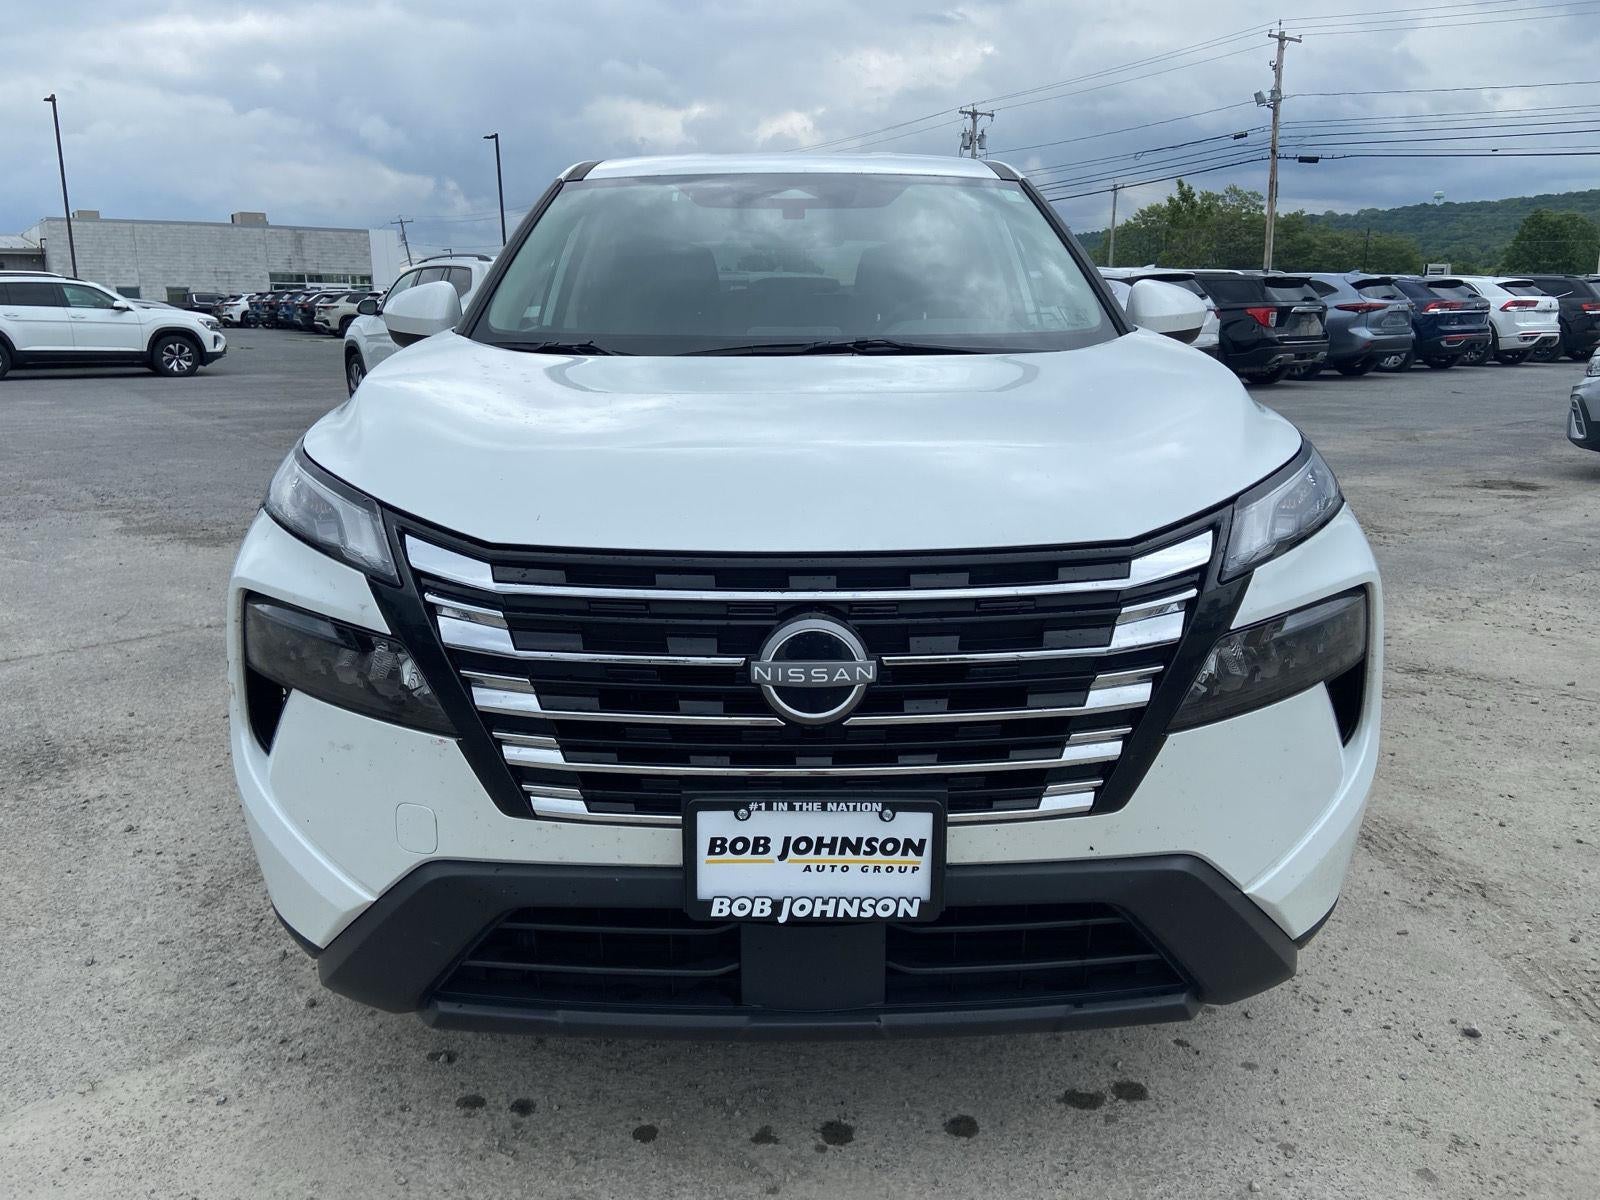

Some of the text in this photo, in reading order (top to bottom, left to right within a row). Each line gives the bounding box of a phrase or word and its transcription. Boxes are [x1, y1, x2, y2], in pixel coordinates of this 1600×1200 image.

[754, 666, 873, 682] NISSAN
[749, 802, 882, 812] #1 IN THE NATION
[707, 836, 927, 861] BOB JOHNSON
[802, 865, 920, 874] AUTO GROUP
[710, 897, 921, 923] BOB JOHNSON
